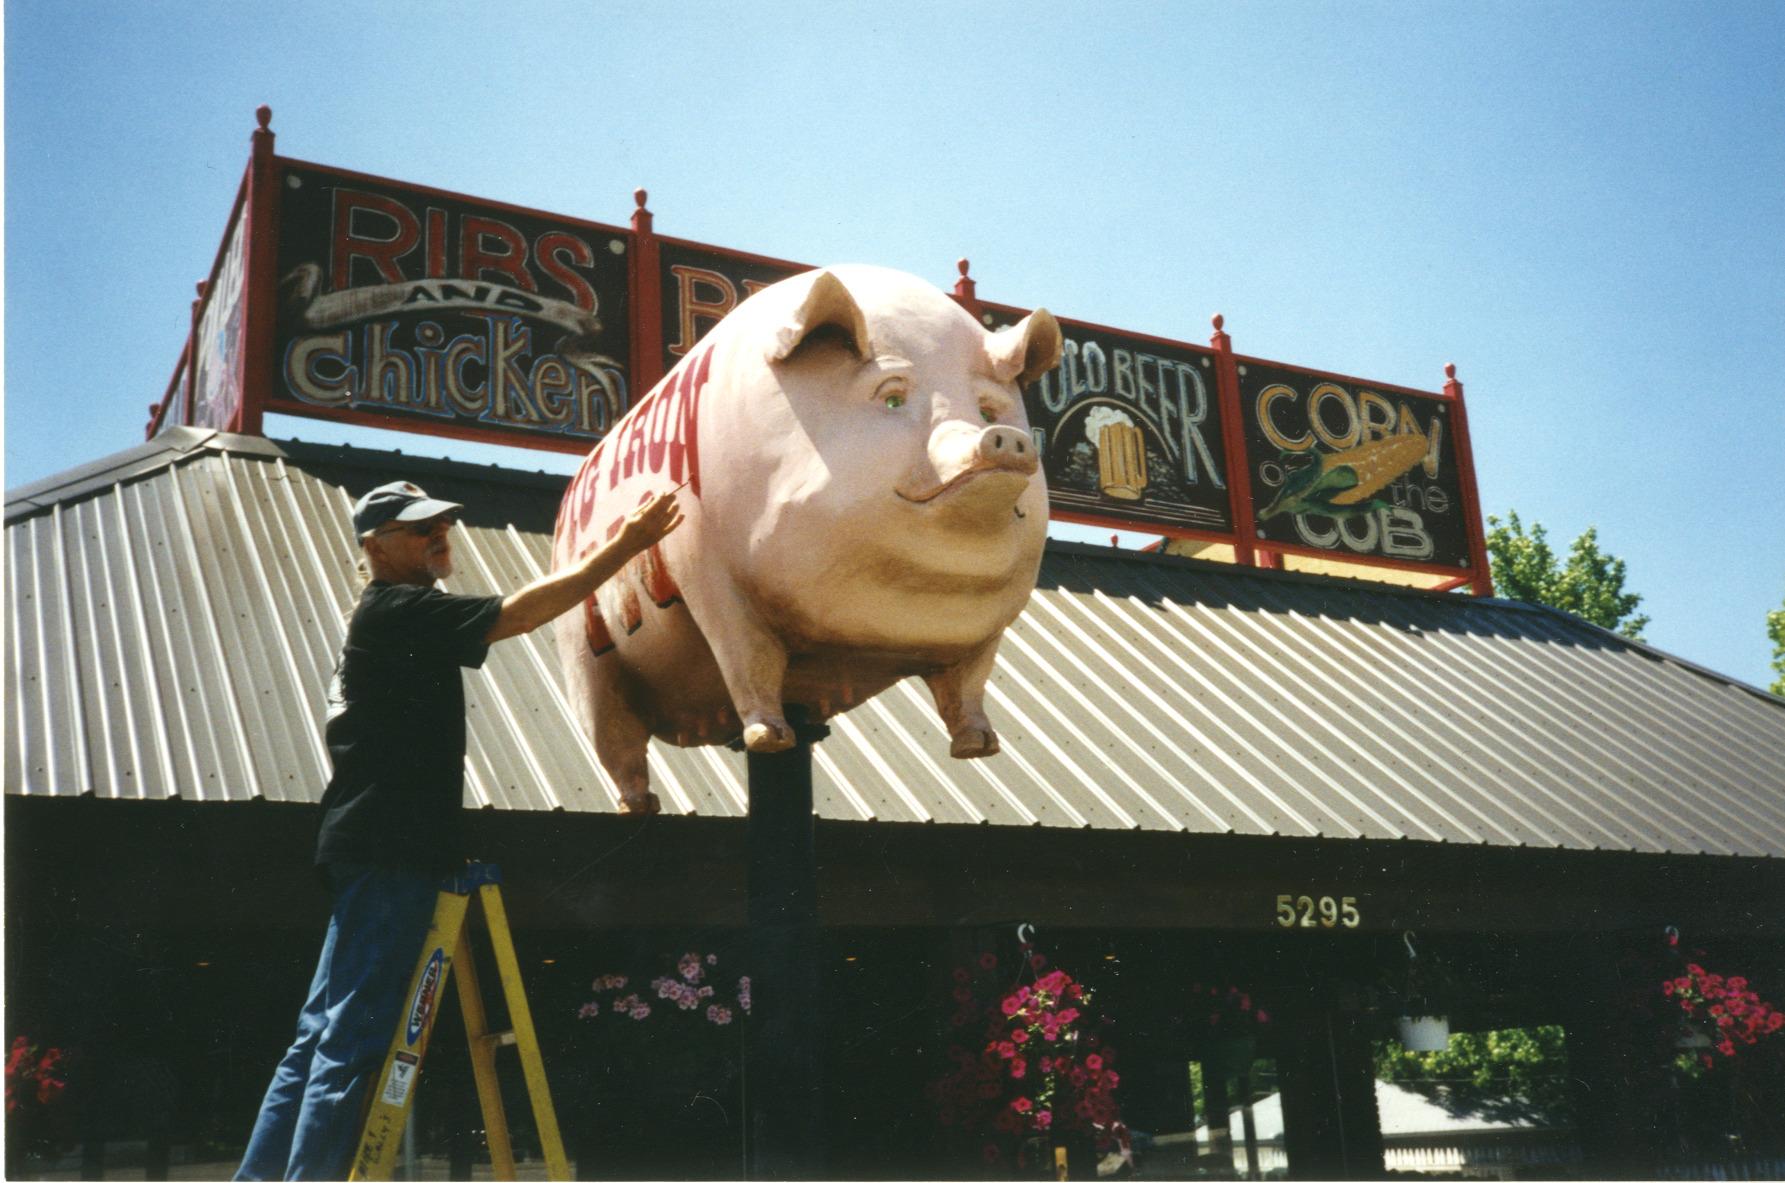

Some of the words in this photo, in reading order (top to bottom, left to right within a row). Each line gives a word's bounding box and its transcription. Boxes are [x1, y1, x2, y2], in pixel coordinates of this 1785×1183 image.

[330, 187, 599, 317] RIBS
[401, 283, 545, 313] AND
[283, 315, 628, 438] Chicken
[609, 343, 716, 501] IRON
[1113, 348, 1226, 490] BEER
[1255, 382, 1442, 480] CORN
[1291, 504, 1435, 561] COB
[1391, 470, 1449, 514] the
[1277, 894, 1360, 928] 5295
